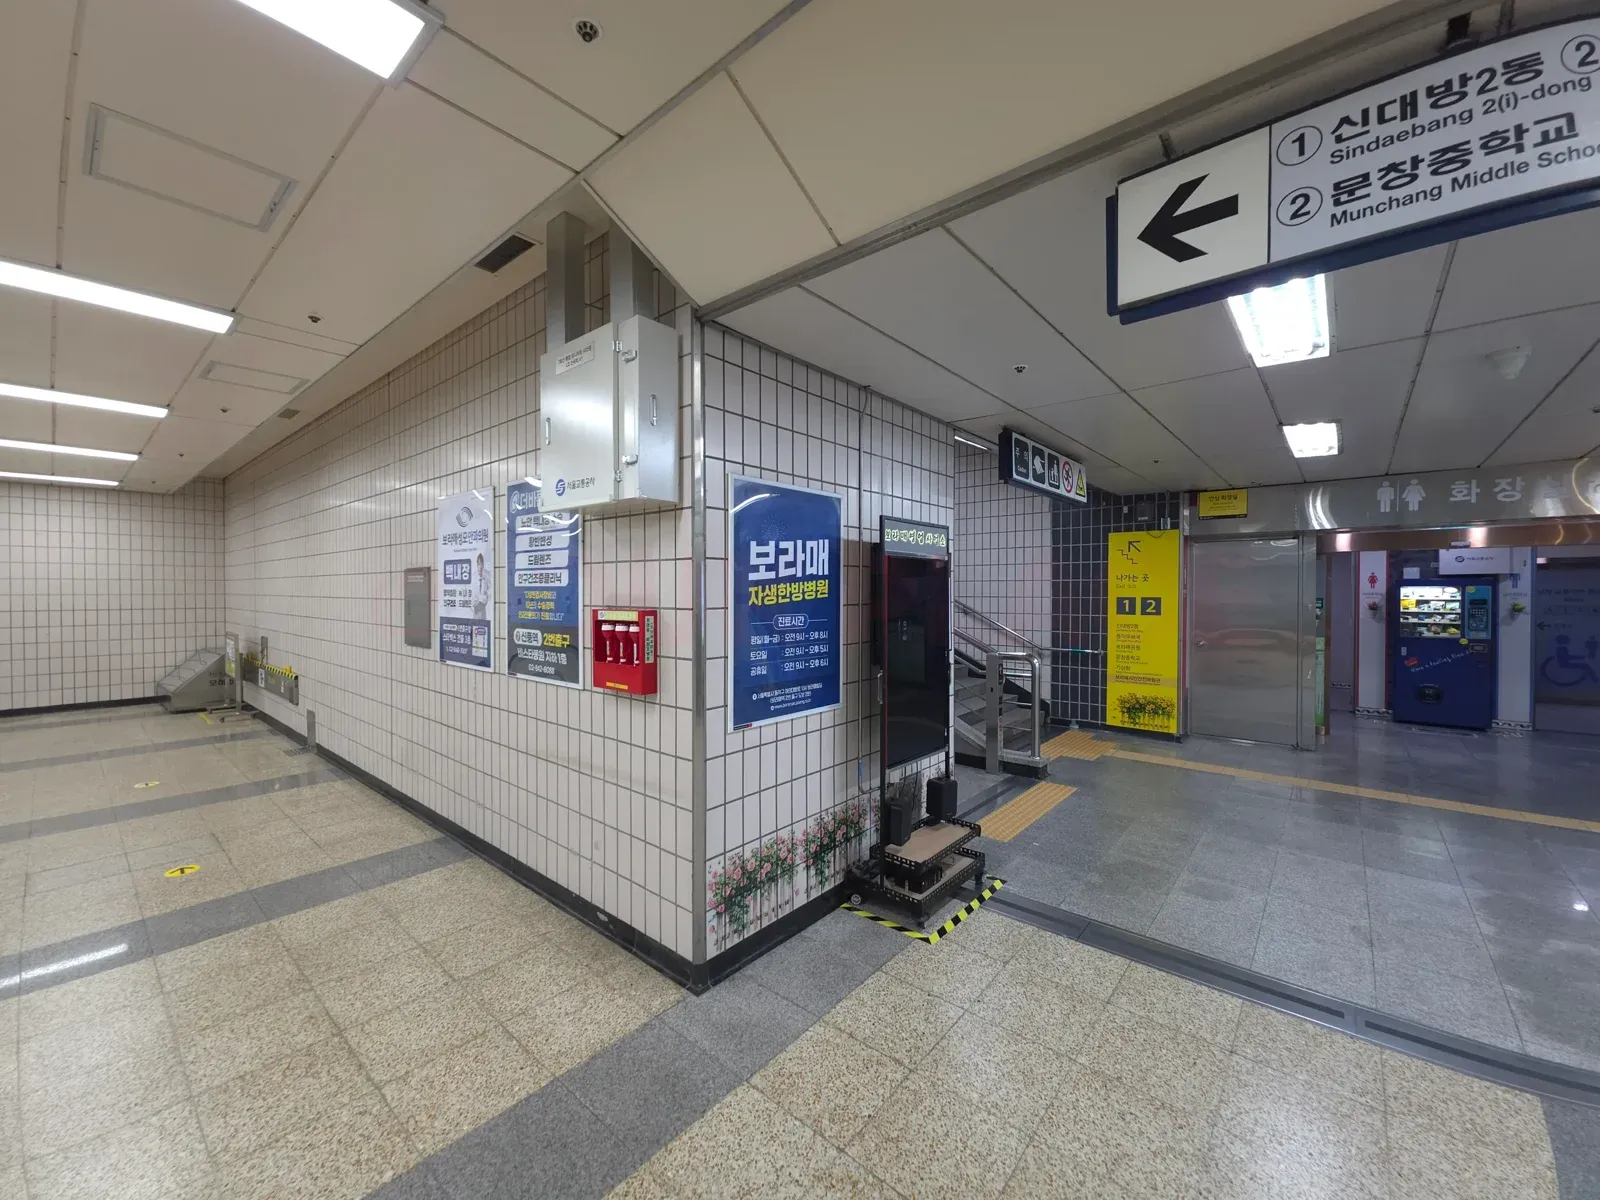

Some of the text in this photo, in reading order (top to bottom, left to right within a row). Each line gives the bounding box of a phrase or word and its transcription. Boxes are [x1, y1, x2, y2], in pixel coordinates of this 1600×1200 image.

[1330, 51, 1545, 145] 신대방2동
[1329, 75, 1593, 165] Sindaebang 2(i)-dong
[1330, 111, 1579, 208] 문창중학교
[1329, 185, 1443, 228] Munchang
[1450, 159, 1530, 193] Middle
[567, 477, 596, 490] 서울교통공사
[528, 535, 553, 548] 황반변성
[528, 554, 552, 565] 드림렌즈
[748, 539, 829, 581] 보라매
[445, 563, 470, 580] 백내장
[518, 572, 562, 584] 안구건조증클리닉
[1116, 574, 1150, 582] 나가는 곳
[748, 579, 829, 606] 자생한방병원
[778, 616, 804, 627] 진료시간
[521, 632, 539, 644] 신풍역
[543, 633, 570, 648] 2번출구
[785, 634, 795, 642] 오전
[809, 631, 819, 640] 오후
[750, 650, 767, 660] 토요일
[784, 648, 795, 657] 오전
[809, 645, 819, 654] 오후
[750, 665, 767, 676] 공휴일
[784, 663, 795, 671] 오전
[809, 659, 819, 668] 오후
